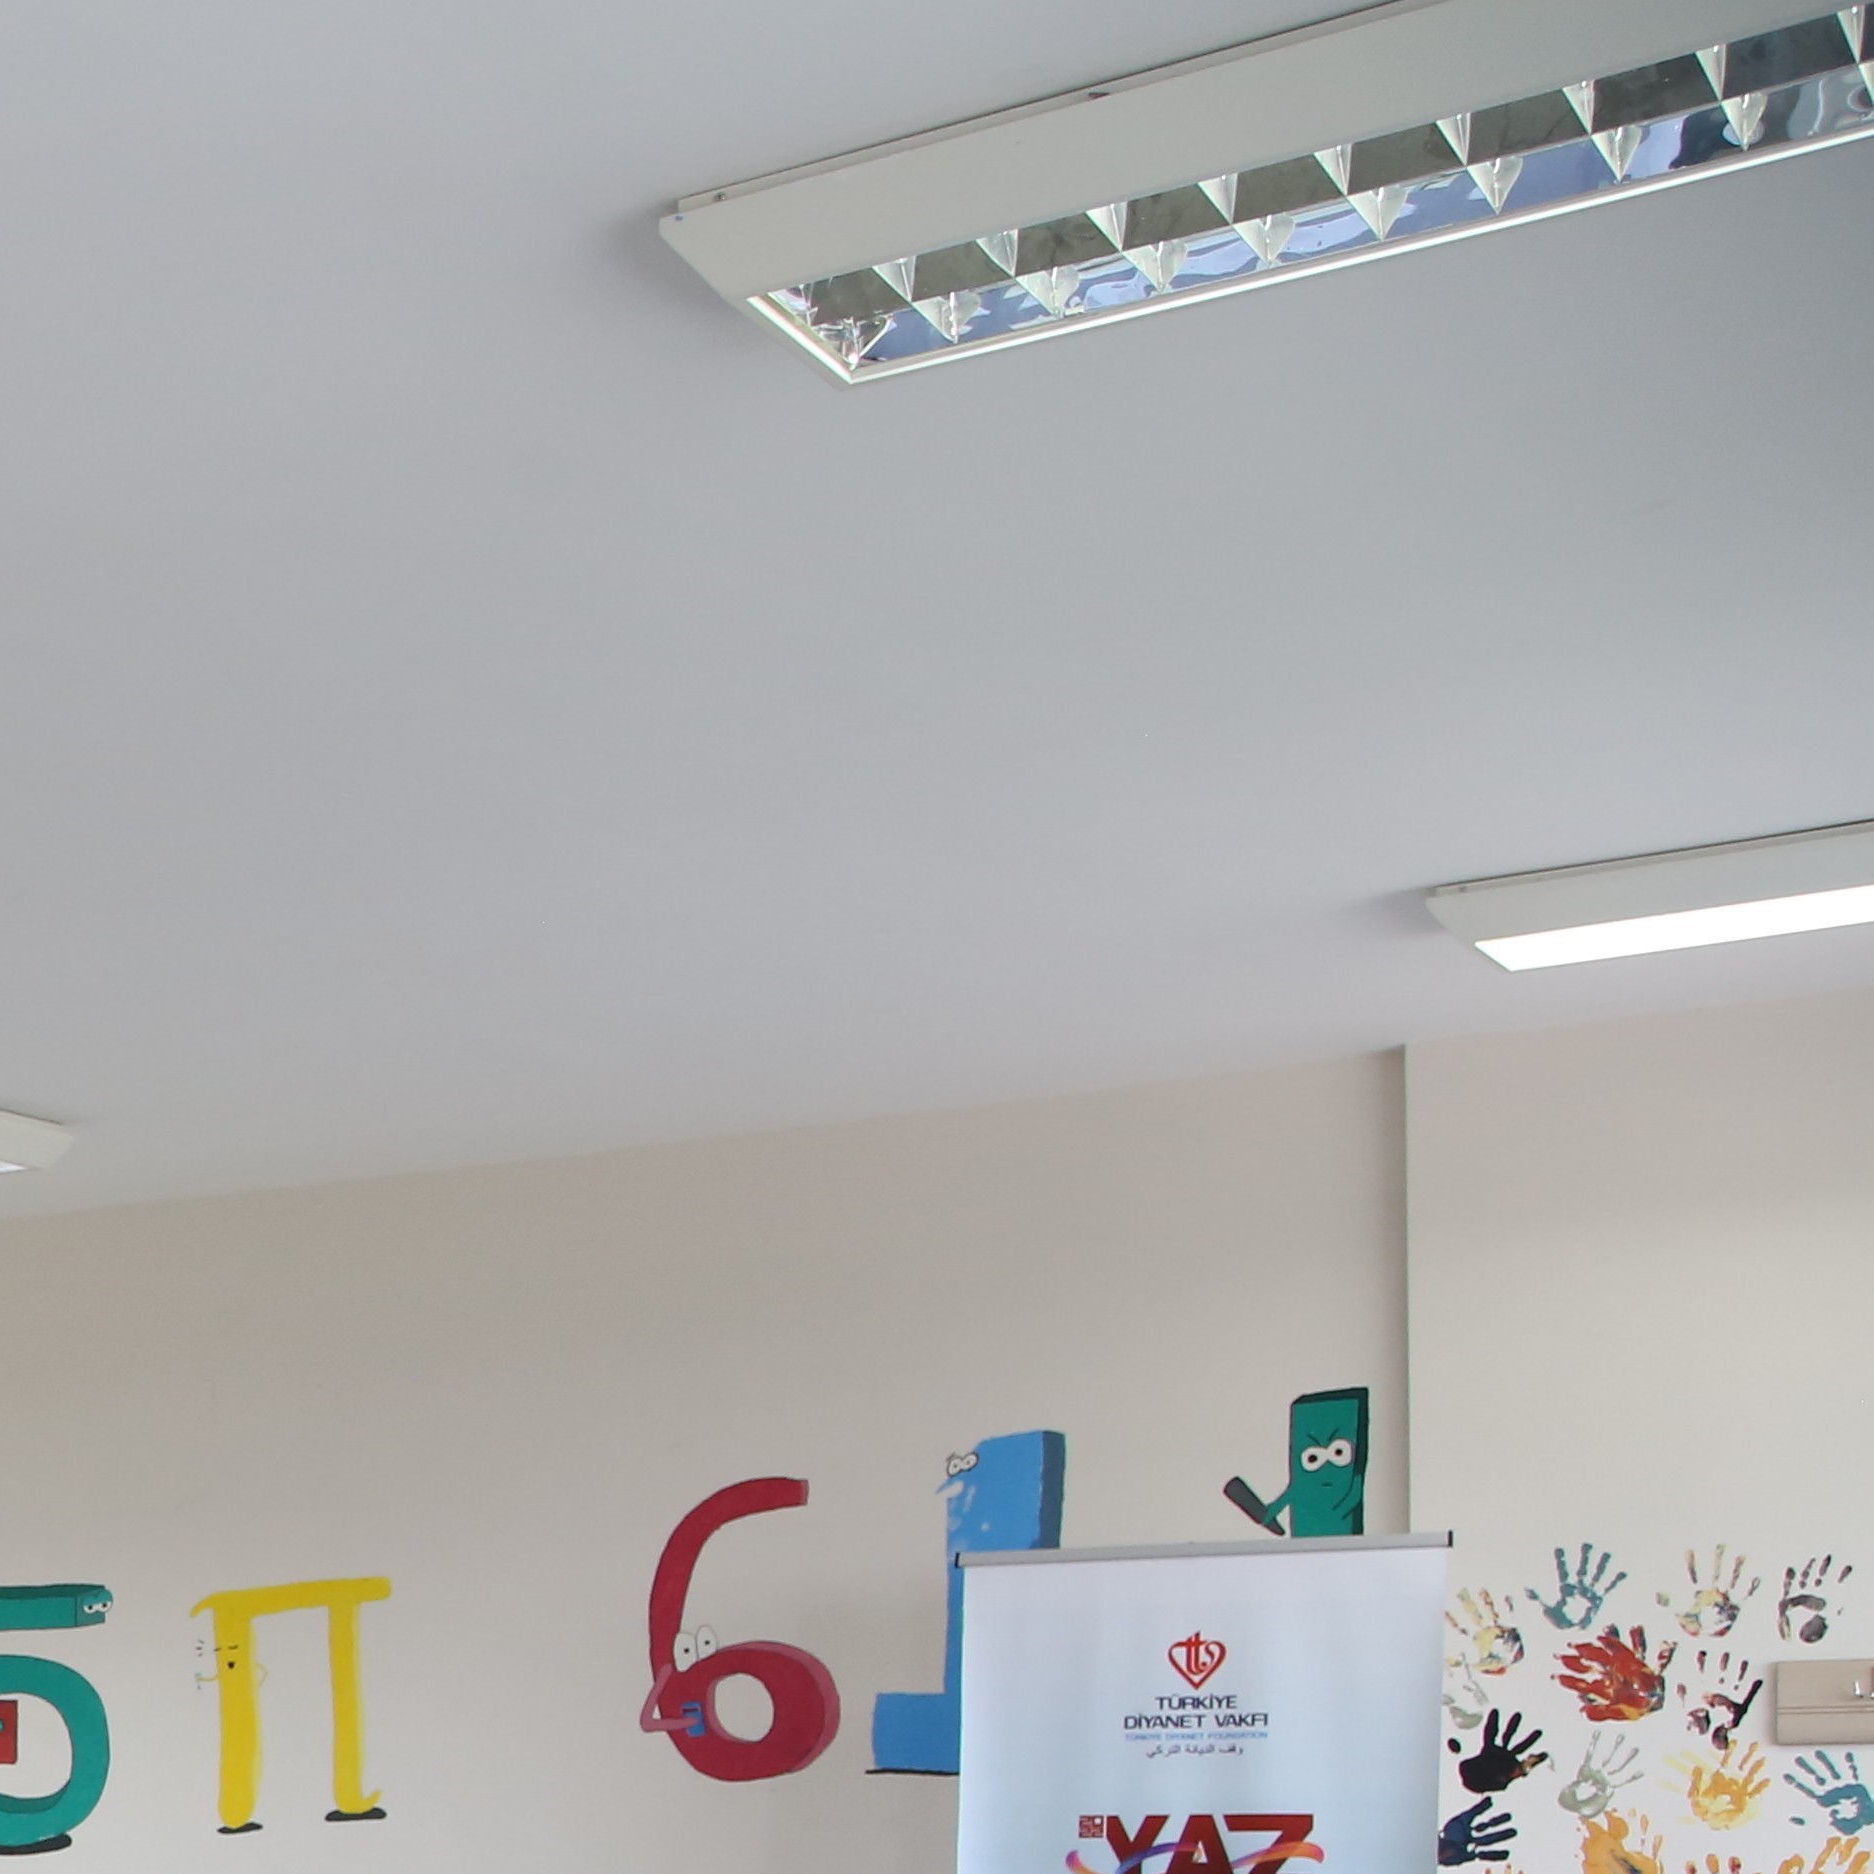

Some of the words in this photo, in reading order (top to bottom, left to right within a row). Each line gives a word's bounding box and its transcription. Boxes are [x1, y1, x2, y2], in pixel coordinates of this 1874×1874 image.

[648, 1475, 840, 1783] 6
[1155, 1694, 1237, 1710] TÜRKİYE
[1124, 1713, 1205, 1730] DİYANET
[1215, 1712, 1268, 1728] VAKFI
